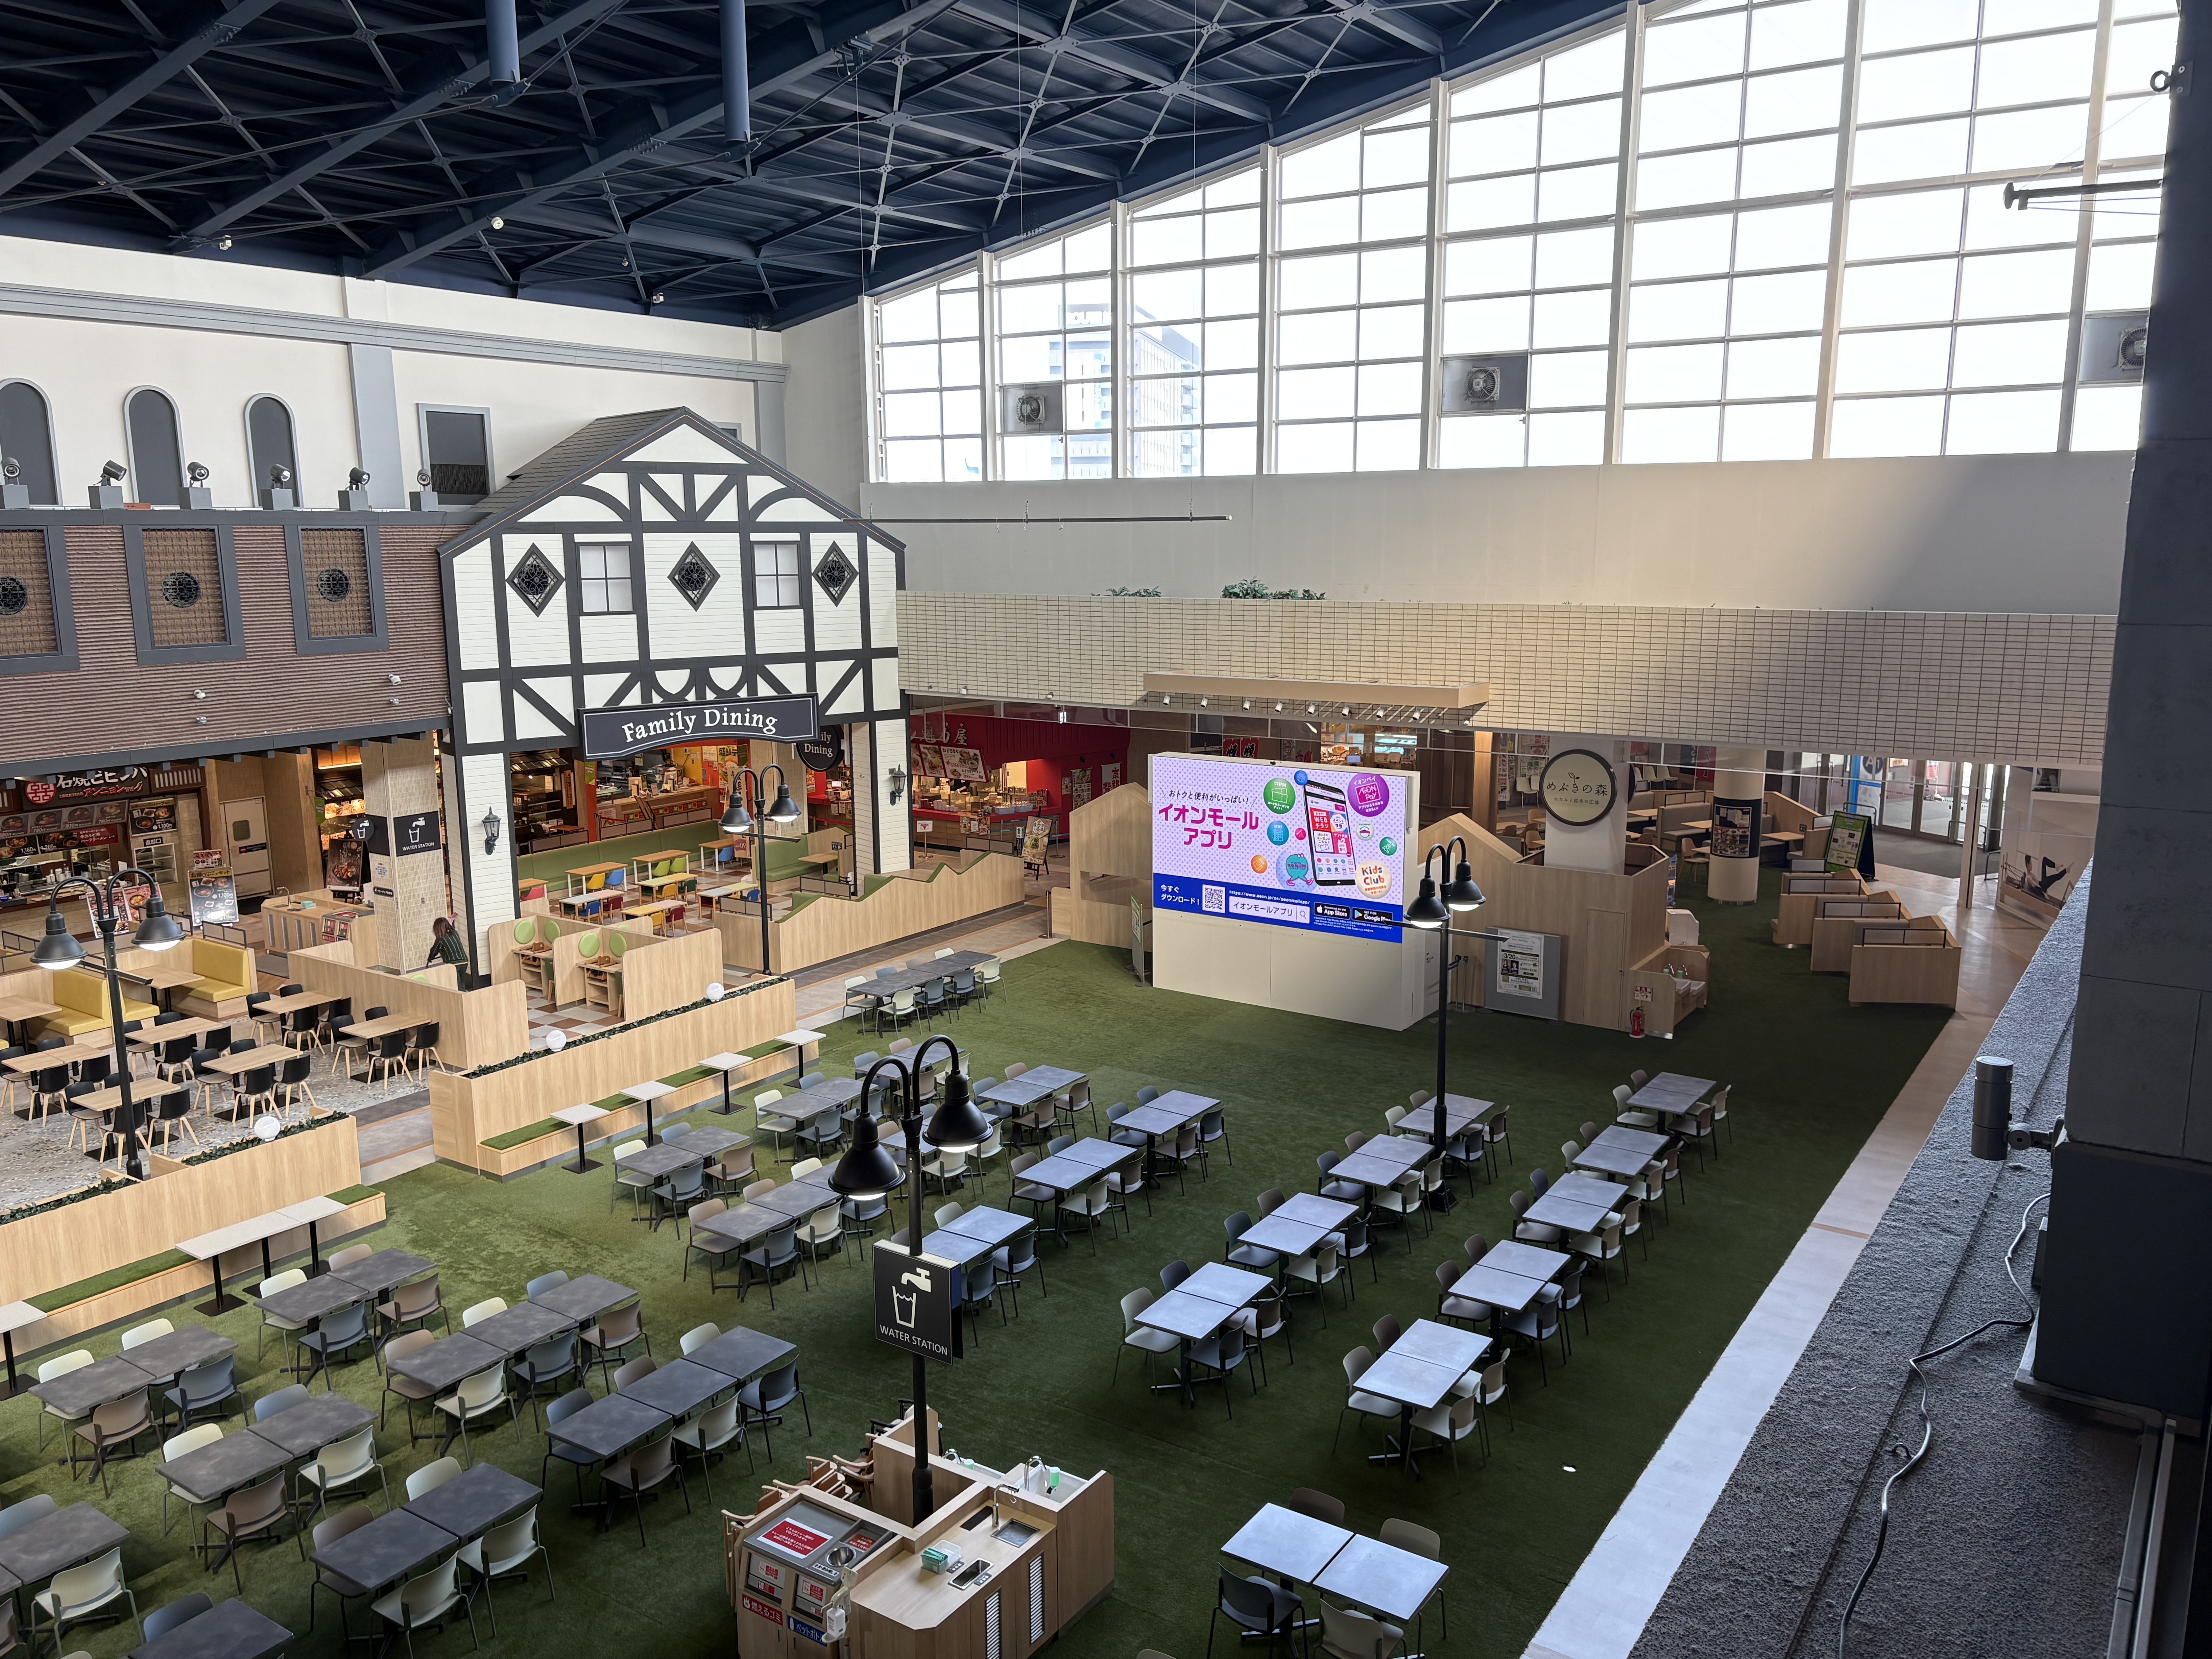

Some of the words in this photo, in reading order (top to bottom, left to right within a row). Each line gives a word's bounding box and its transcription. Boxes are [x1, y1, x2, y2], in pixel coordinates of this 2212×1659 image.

[622, 711, 697, 742] Family
[703, 707, 778, 735] Dining
[821, 732, 832, 744] ily
[804, 743, 833, 757] Dining
[1546, 780, 1607, 797] めぶきの森
[1365, 792, 1377, 801] Pay
[1159, 804, 1259, 830] イオンモール
[1184, 828, 1231, 849] アプリ
[1362, 866, 1382, 876] Kids
[1364, 875, 1385, 885] Club
[1161, 884, 1179, 893] 今すぐ
[1233, 902, 1293, 916] イオンモールアプリ
[880, 1324, 910, 1343] WATER
[912, 1336, 947, 1355] STATION
[751, 1601, 781, 1622] 燃えるゴミ
